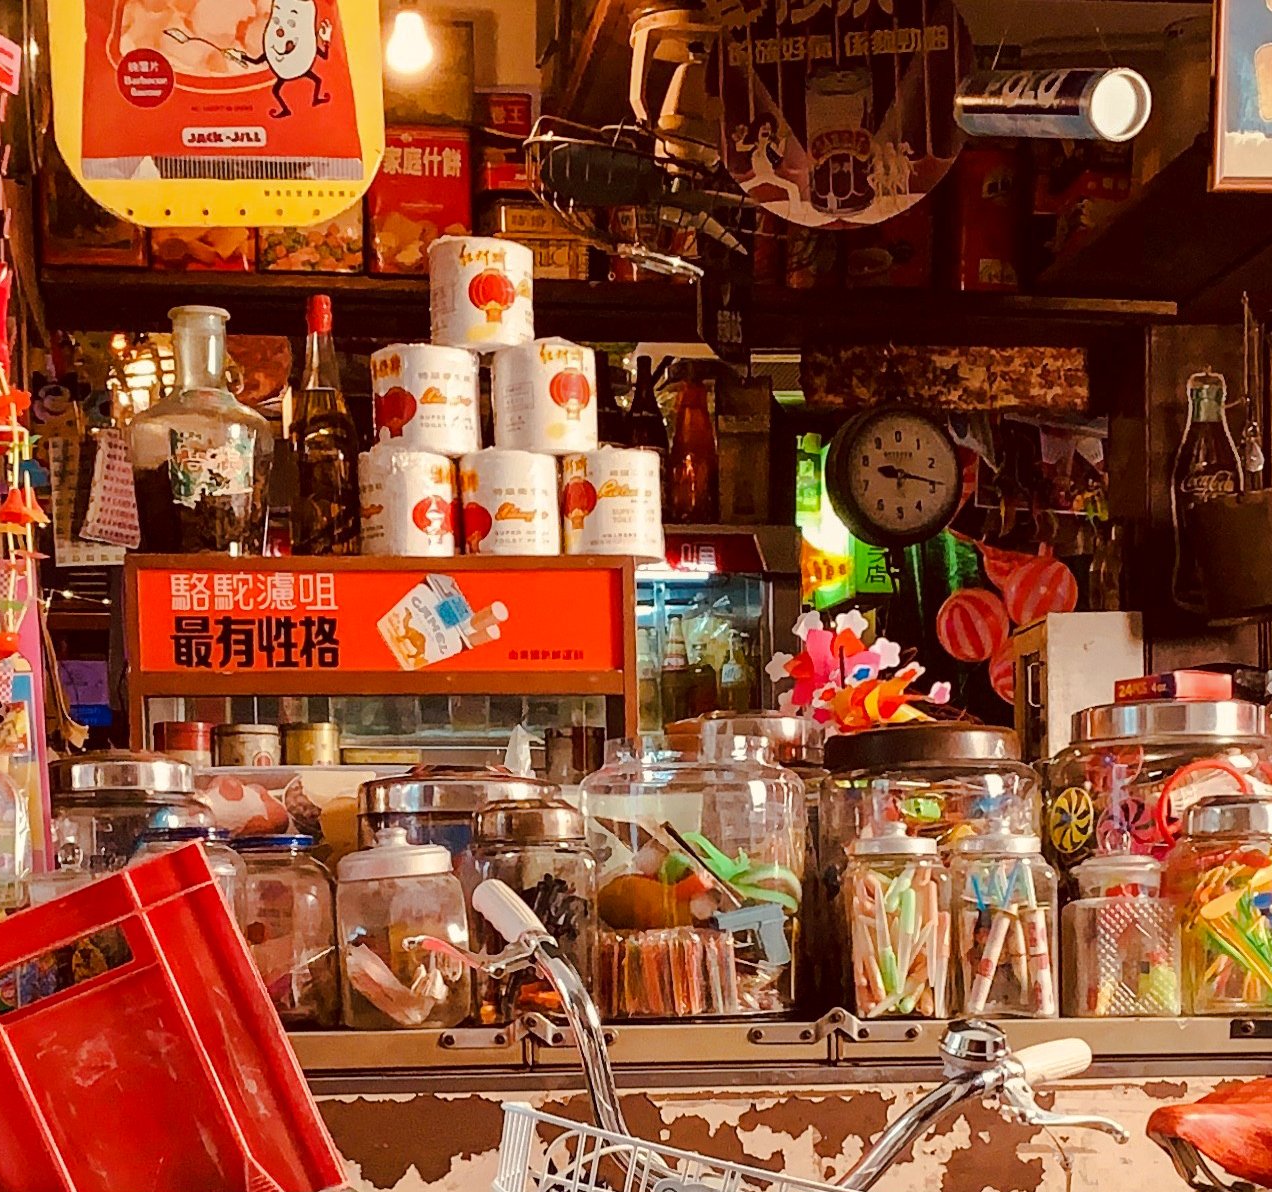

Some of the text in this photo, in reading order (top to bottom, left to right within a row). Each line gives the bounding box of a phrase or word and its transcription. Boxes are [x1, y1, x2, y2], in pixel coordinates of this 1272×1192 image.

[170, 572, 339, 612] 駱駝濾咀
[170, 616, 340, 669] 最有性格
[410, 595, 448, 655] CAMEL
